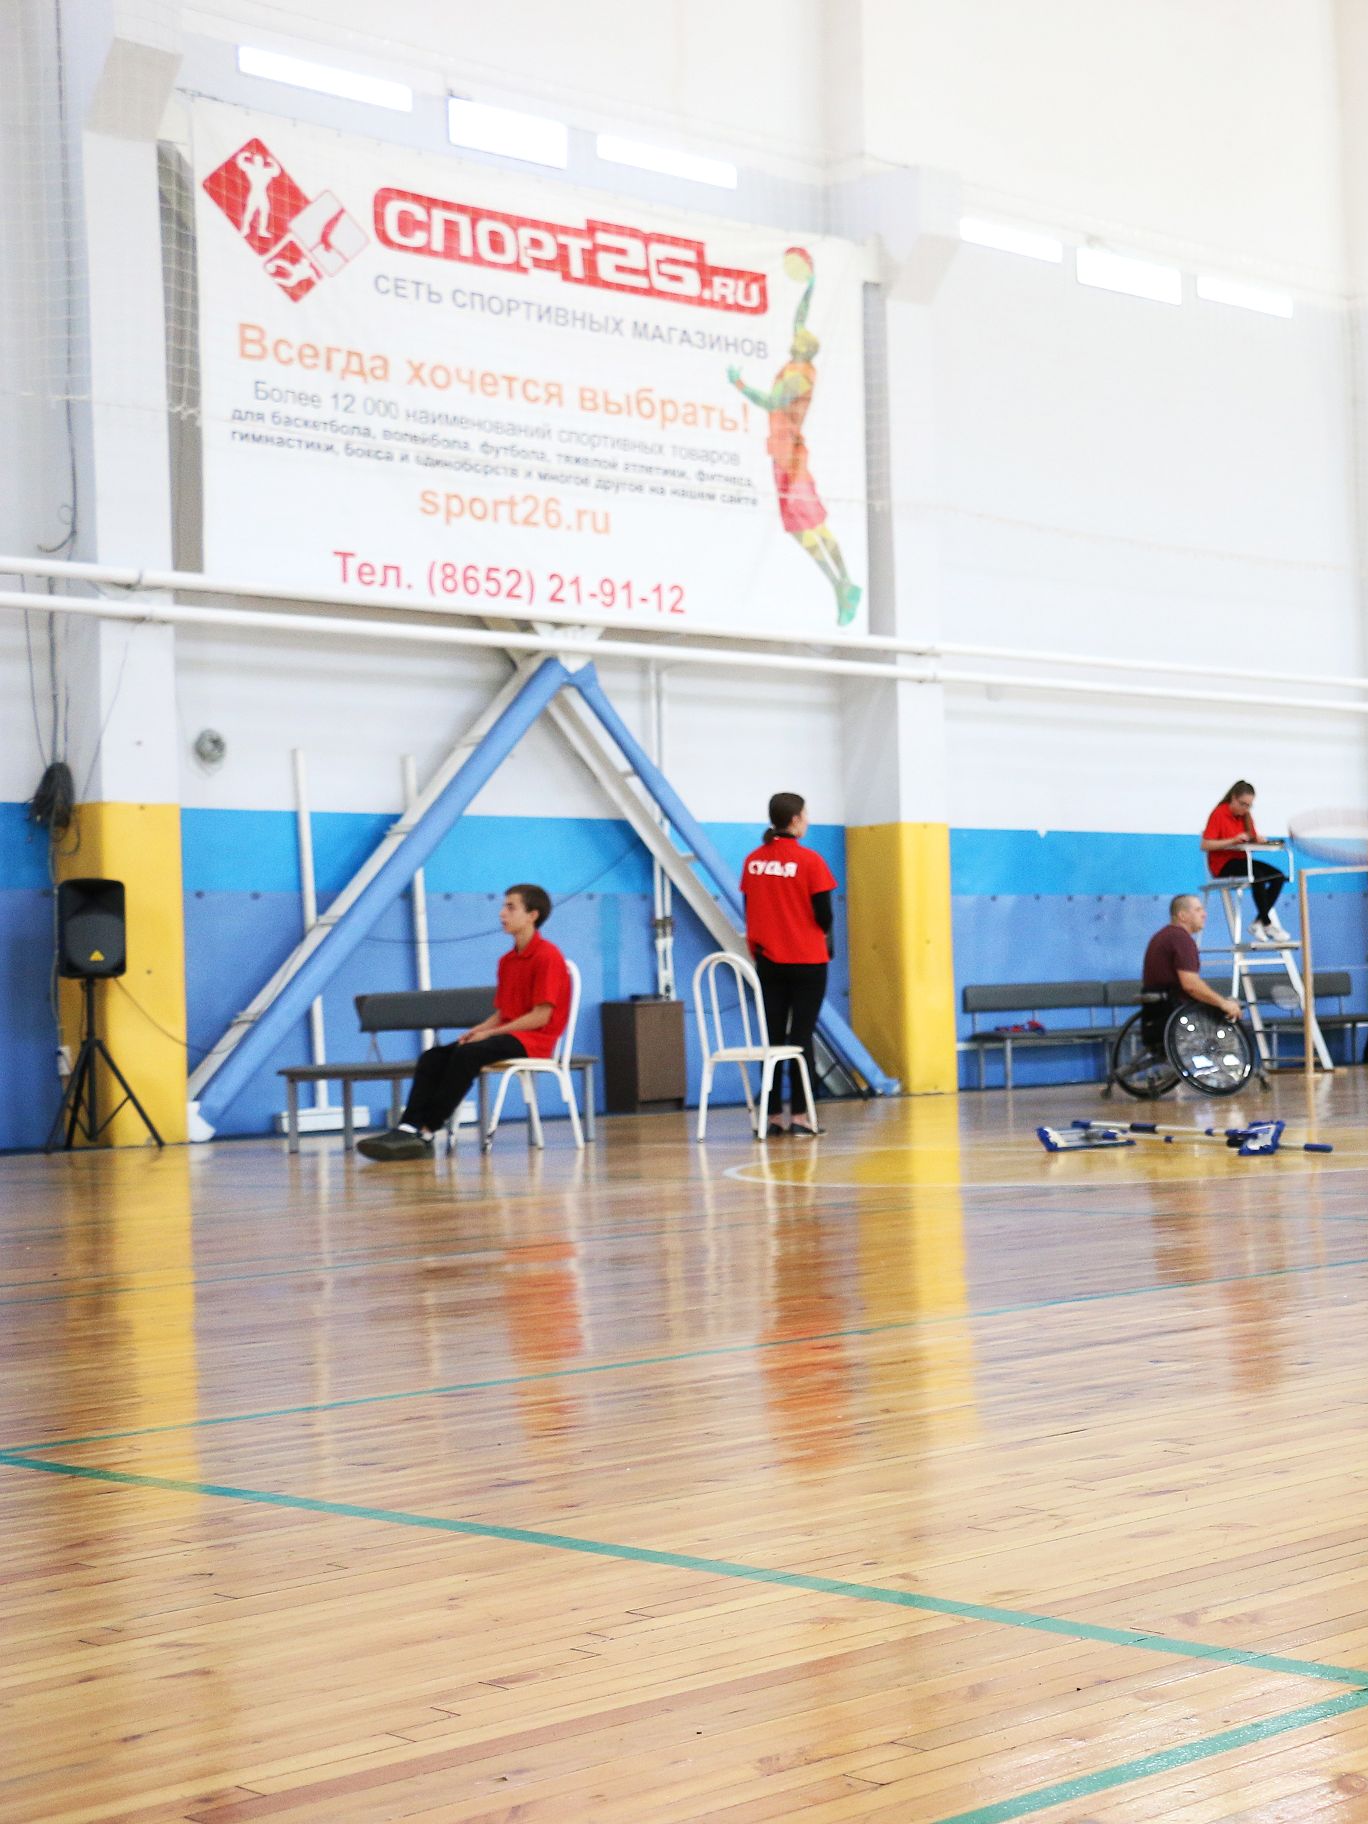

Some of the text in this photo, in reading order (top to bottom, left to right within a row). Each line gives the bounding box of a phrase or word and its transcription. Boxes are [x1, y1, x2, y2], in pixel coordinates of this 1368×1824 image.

[374, 273, 769, 361] СЕТЬ СПОРТИВНЫХ МАГАЗИНОВ
[237, 322, 750, 434] Всегда хочется выбрать!
[231, 408, 266, 424] для
[253, 379, 323, 410] Более
[330, 392, 356, 414] 12
[405, 406, 551, 442] наименований
[557, 427, 665, 457] спортивных
[671, 444, 741, 467] товаров
[344, 443, 395, 462] бокса
[420, 489, 611, 535] sport26.ru
[334, 550, 686, 614] Тел. (8652) 21-91-12
